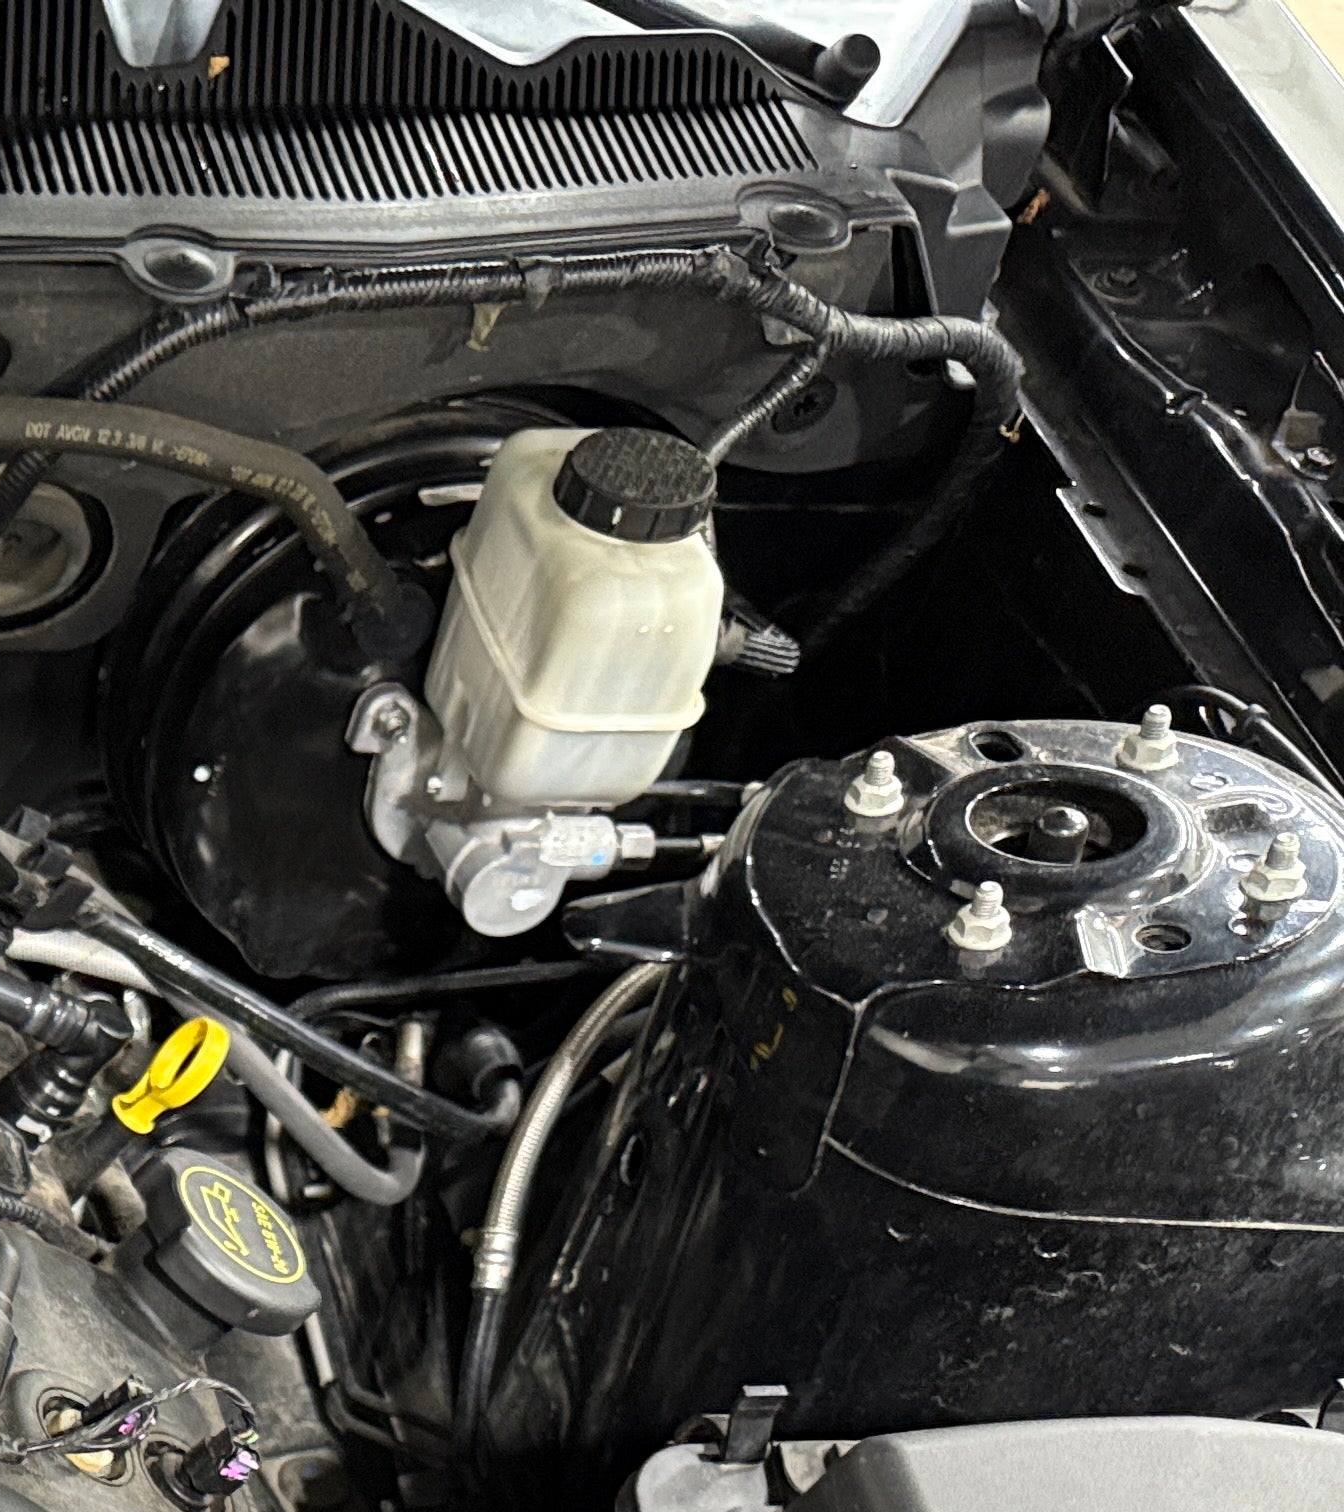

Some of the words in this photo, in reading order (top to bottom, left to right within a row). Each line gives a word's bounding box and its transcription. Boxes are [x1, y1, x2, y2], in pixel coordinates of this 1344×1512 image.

[25, 421, 52, 438] DOT
[251, 1201, 273, 1231] SAE
[261, 1228, 290, 1275] 5W-20
